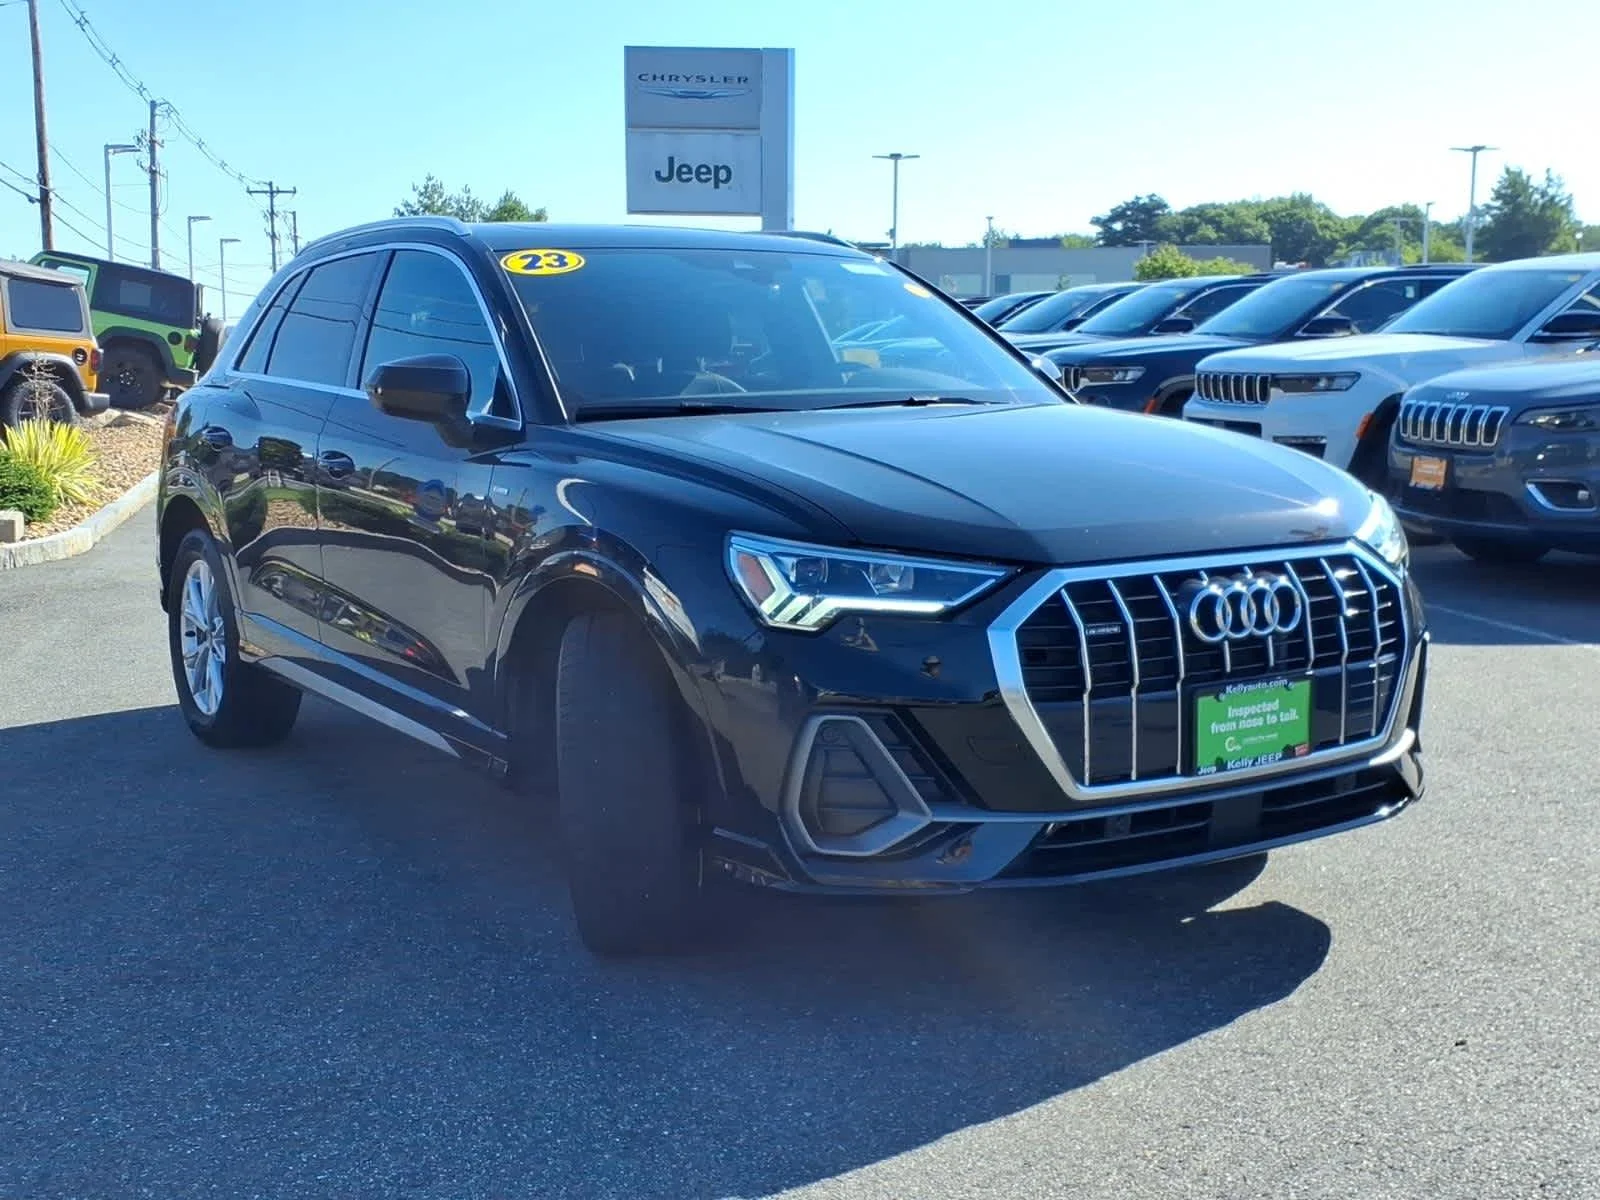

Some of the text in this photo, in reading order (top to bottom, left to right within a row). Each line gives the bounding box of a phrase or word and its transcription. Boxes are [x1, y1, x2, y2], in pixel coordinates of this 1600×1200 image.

[638, 73, 749, 84] CHRYSLER
[655, 156, 732, 189] Jeep
[519, 252, 569, 270] 23
[1228, 699, 1280, 719] Inspected
[1211, 720, 1237, 734] from
[1239, 717, 1264, 729] nose
[1266, 714, 1278, 724] to
[1227, 752, 1282, 770] Kelly JEEP
